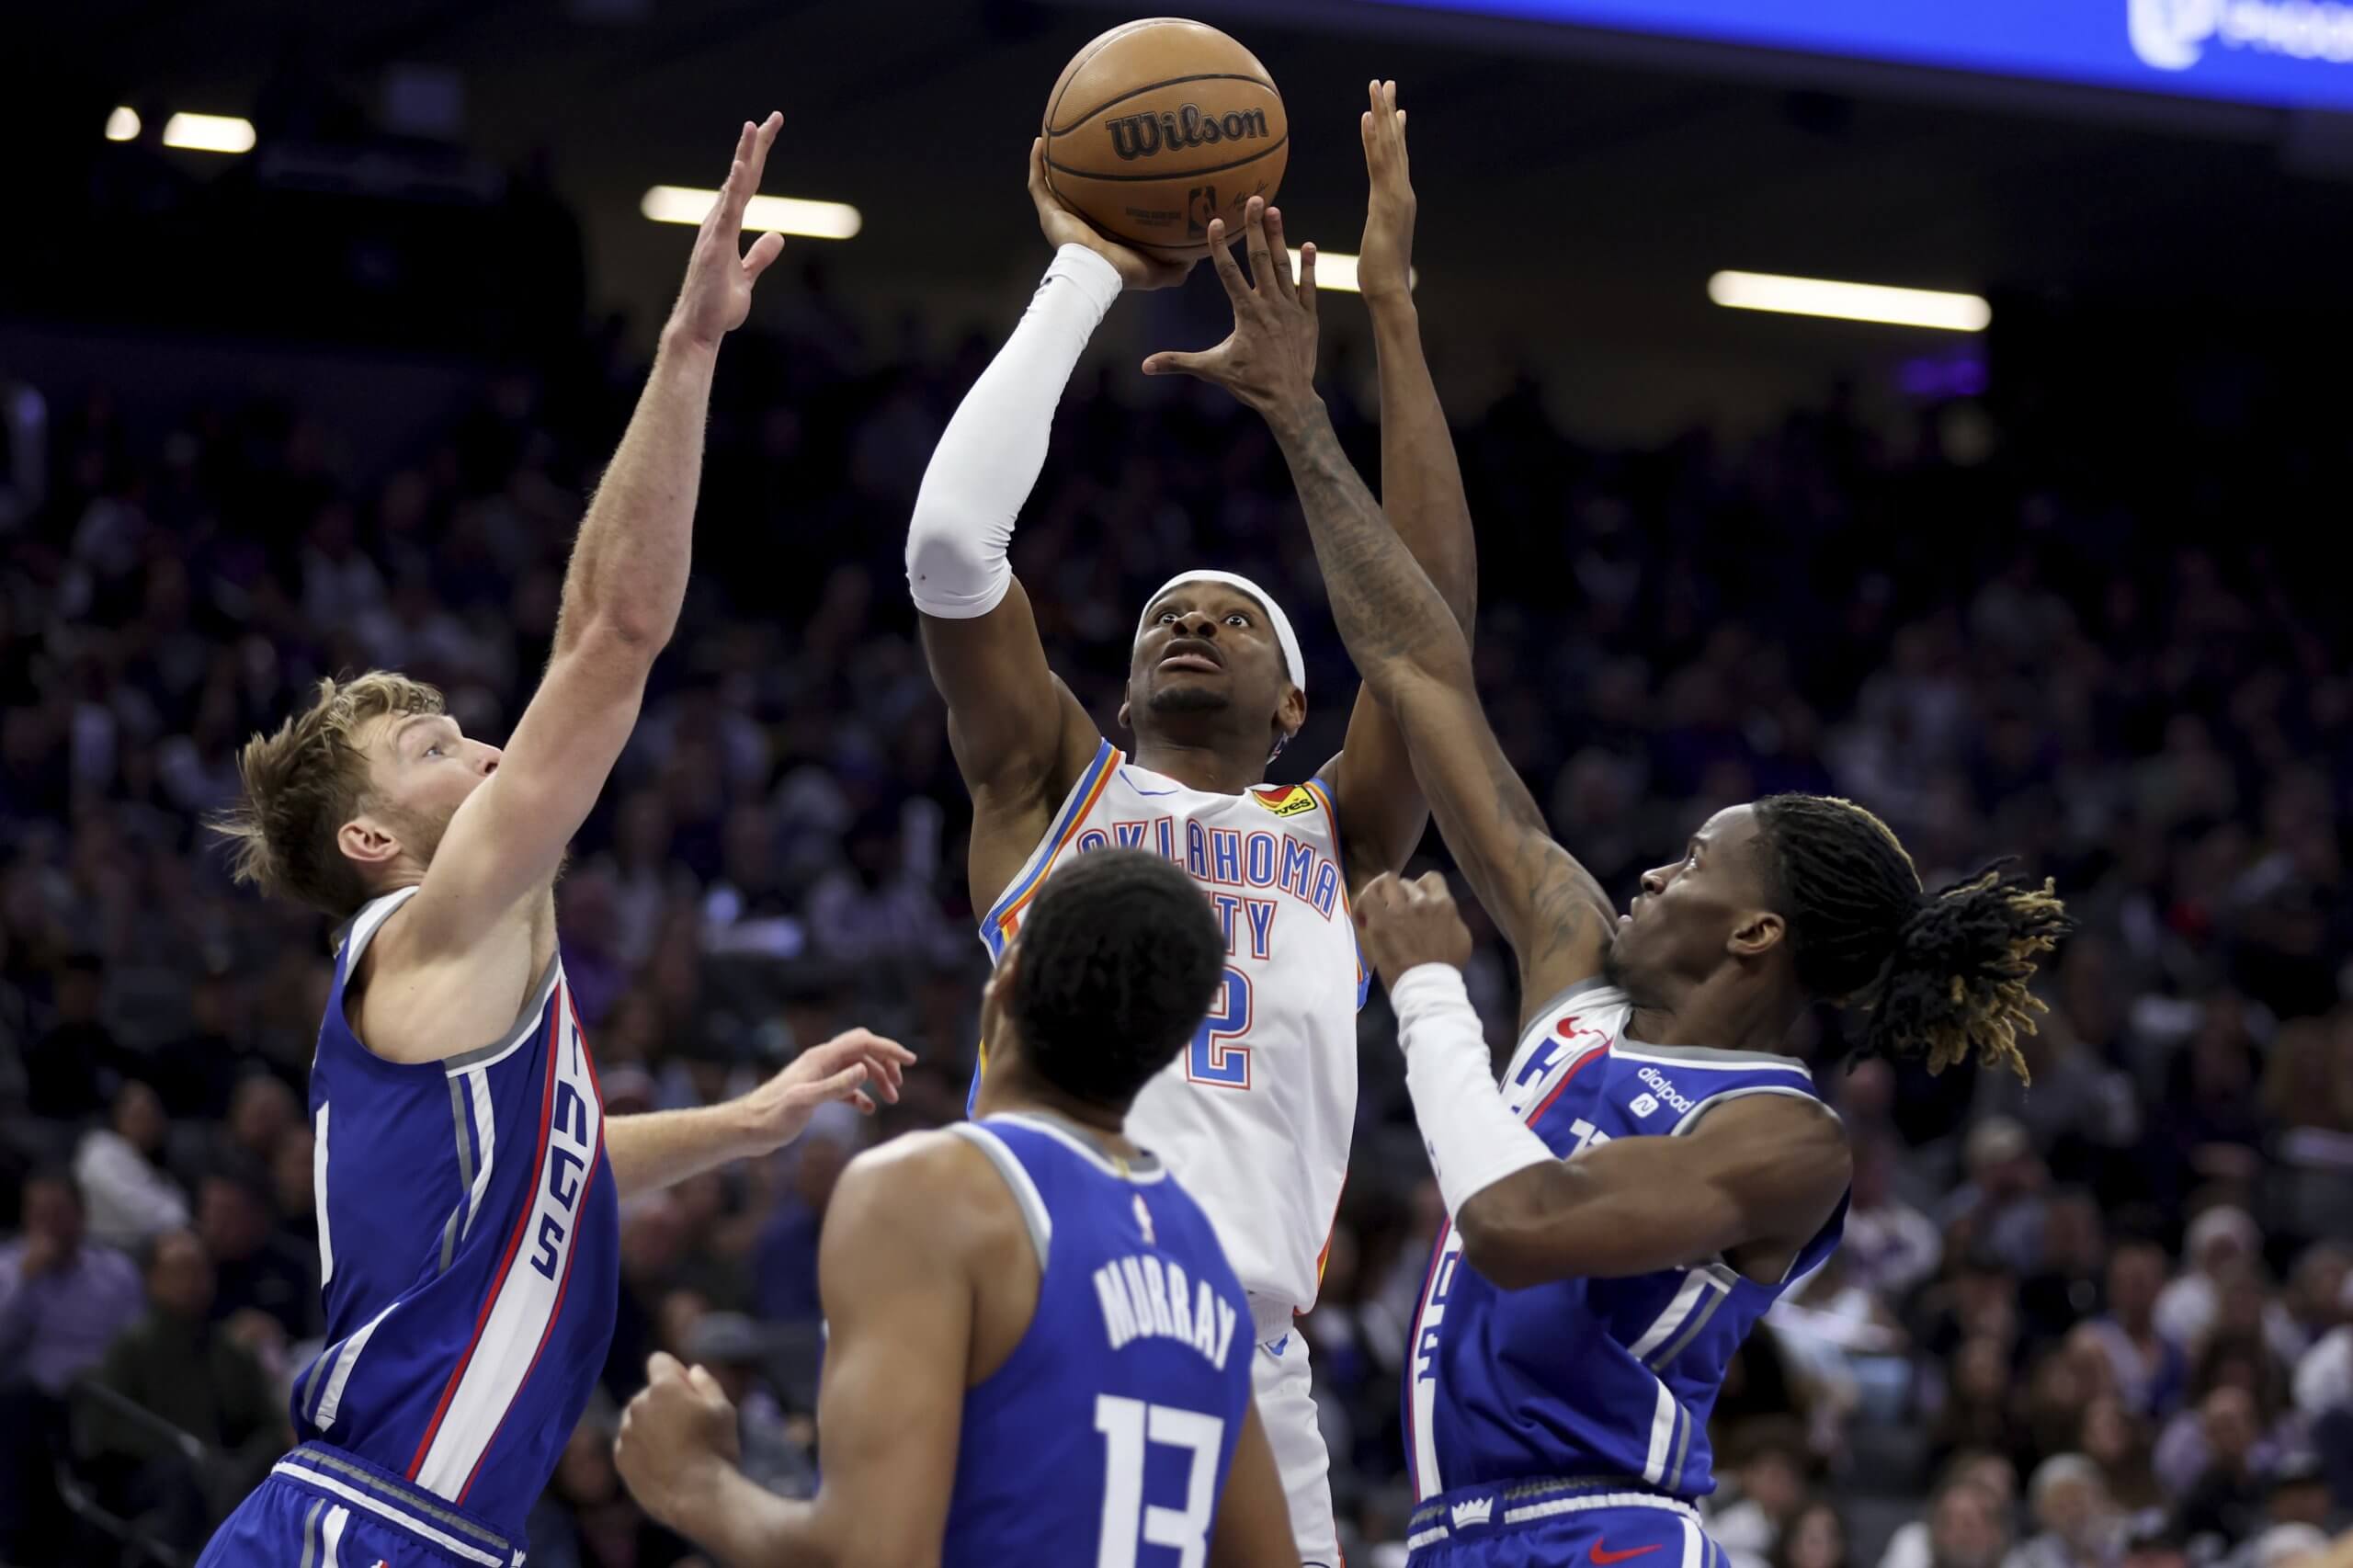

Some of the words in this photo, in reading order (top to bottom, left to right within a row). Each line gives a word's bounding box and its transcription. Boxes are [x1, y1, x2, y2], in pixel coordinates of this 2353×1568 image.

[1105, 102, 1269, 160] Wilson
[1204, 891, 1278, 960] TY
[1186, 964, 1251, 1090] 2
[1637, 1066, 1696, 1114] dialpad
[1093, 1254, 1236, 1371] MURRAY
[1094, 1392, 1225, 1568] 13
